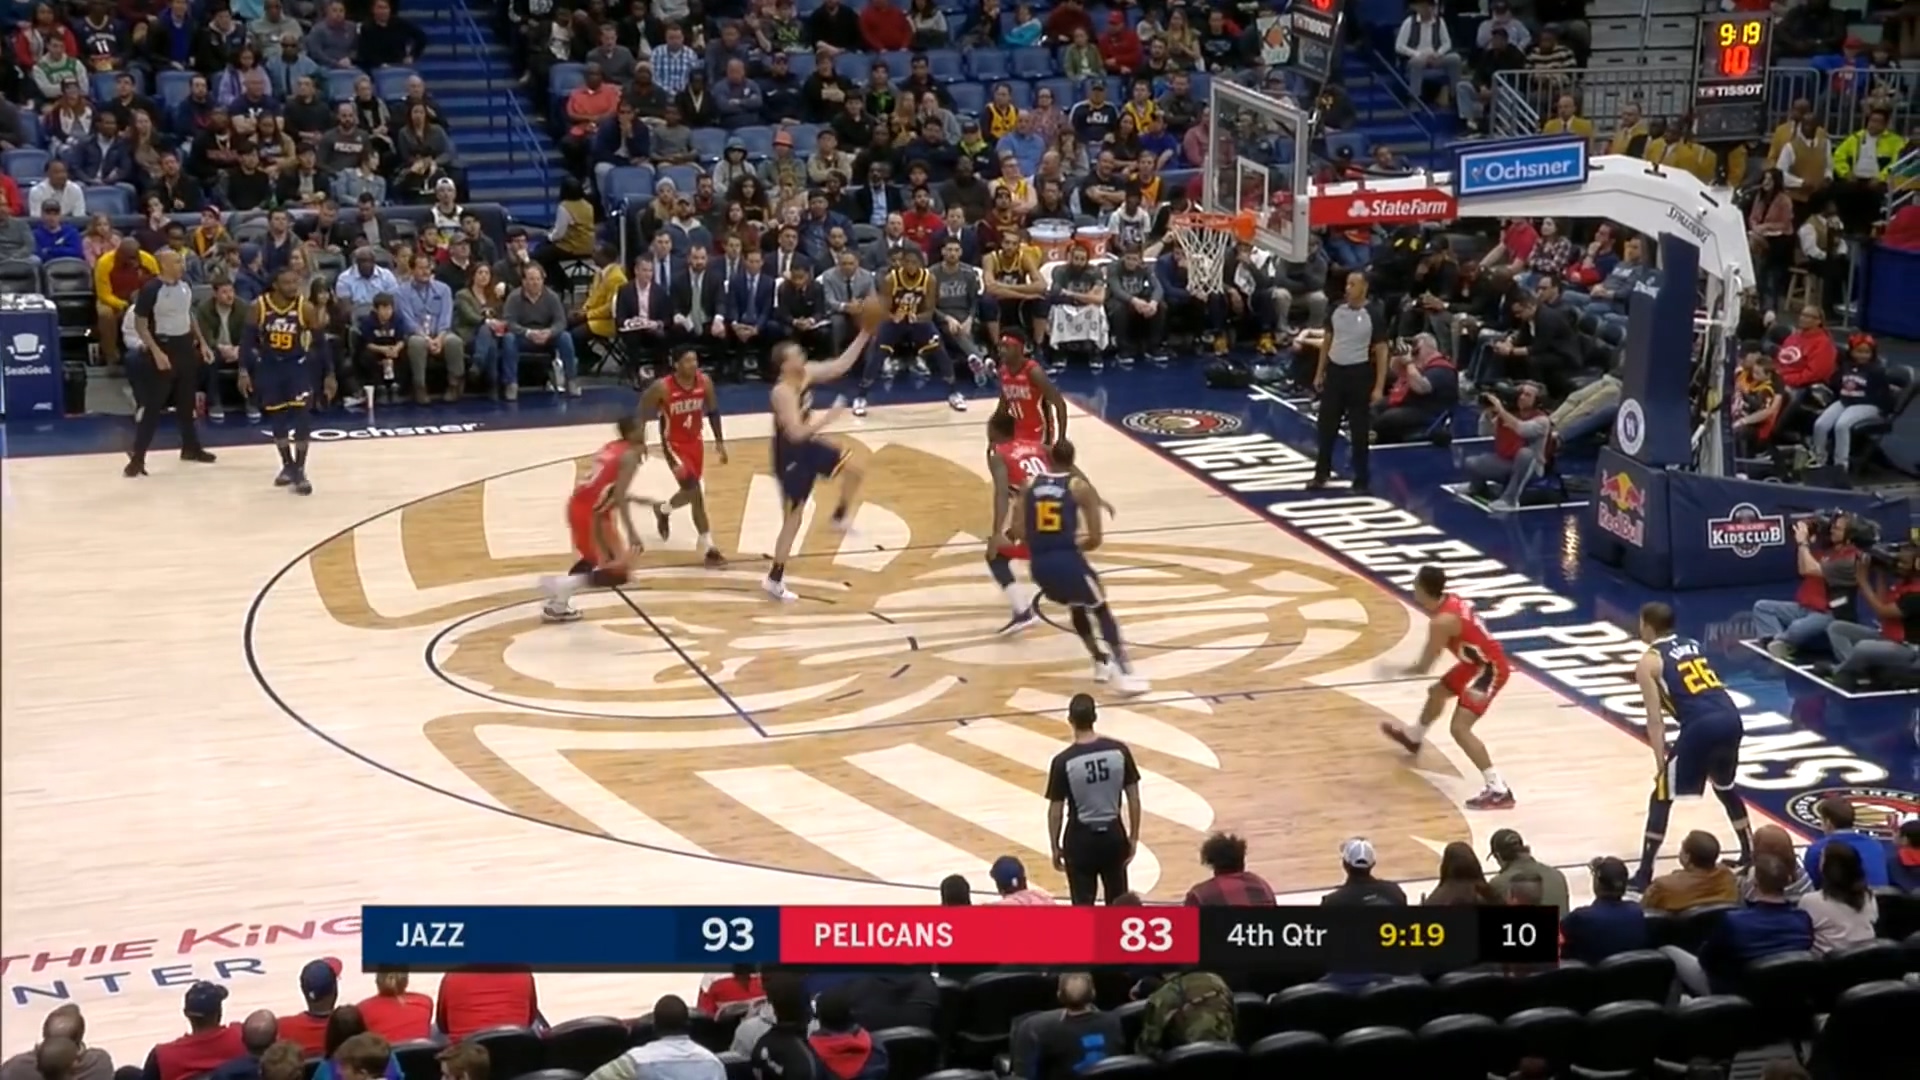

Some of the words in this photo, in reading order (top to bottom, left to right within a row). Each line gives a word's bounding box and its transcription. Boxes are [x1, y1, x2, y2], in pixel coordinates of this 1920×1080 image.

[1720, 22, 1761, 46] 9:19
[1724, 45, 1750, 76] 10
[1716, 84, 1763, 97] TISSOT
[1485, 160, 1572, 181] Ochsner
[269, 332, 293, 350] 99
[4, 365, 52, 377] SeatGeek
[309, 421, 478, 441] Ochsner
[682, 415, 693, 430] 4
[1156, 433, 1352, 492] NEW
[1035, 501, 1063, 532] 15
[1677, 657, 1724, 694] 26
[1084, 758, 1110, 784] 35
